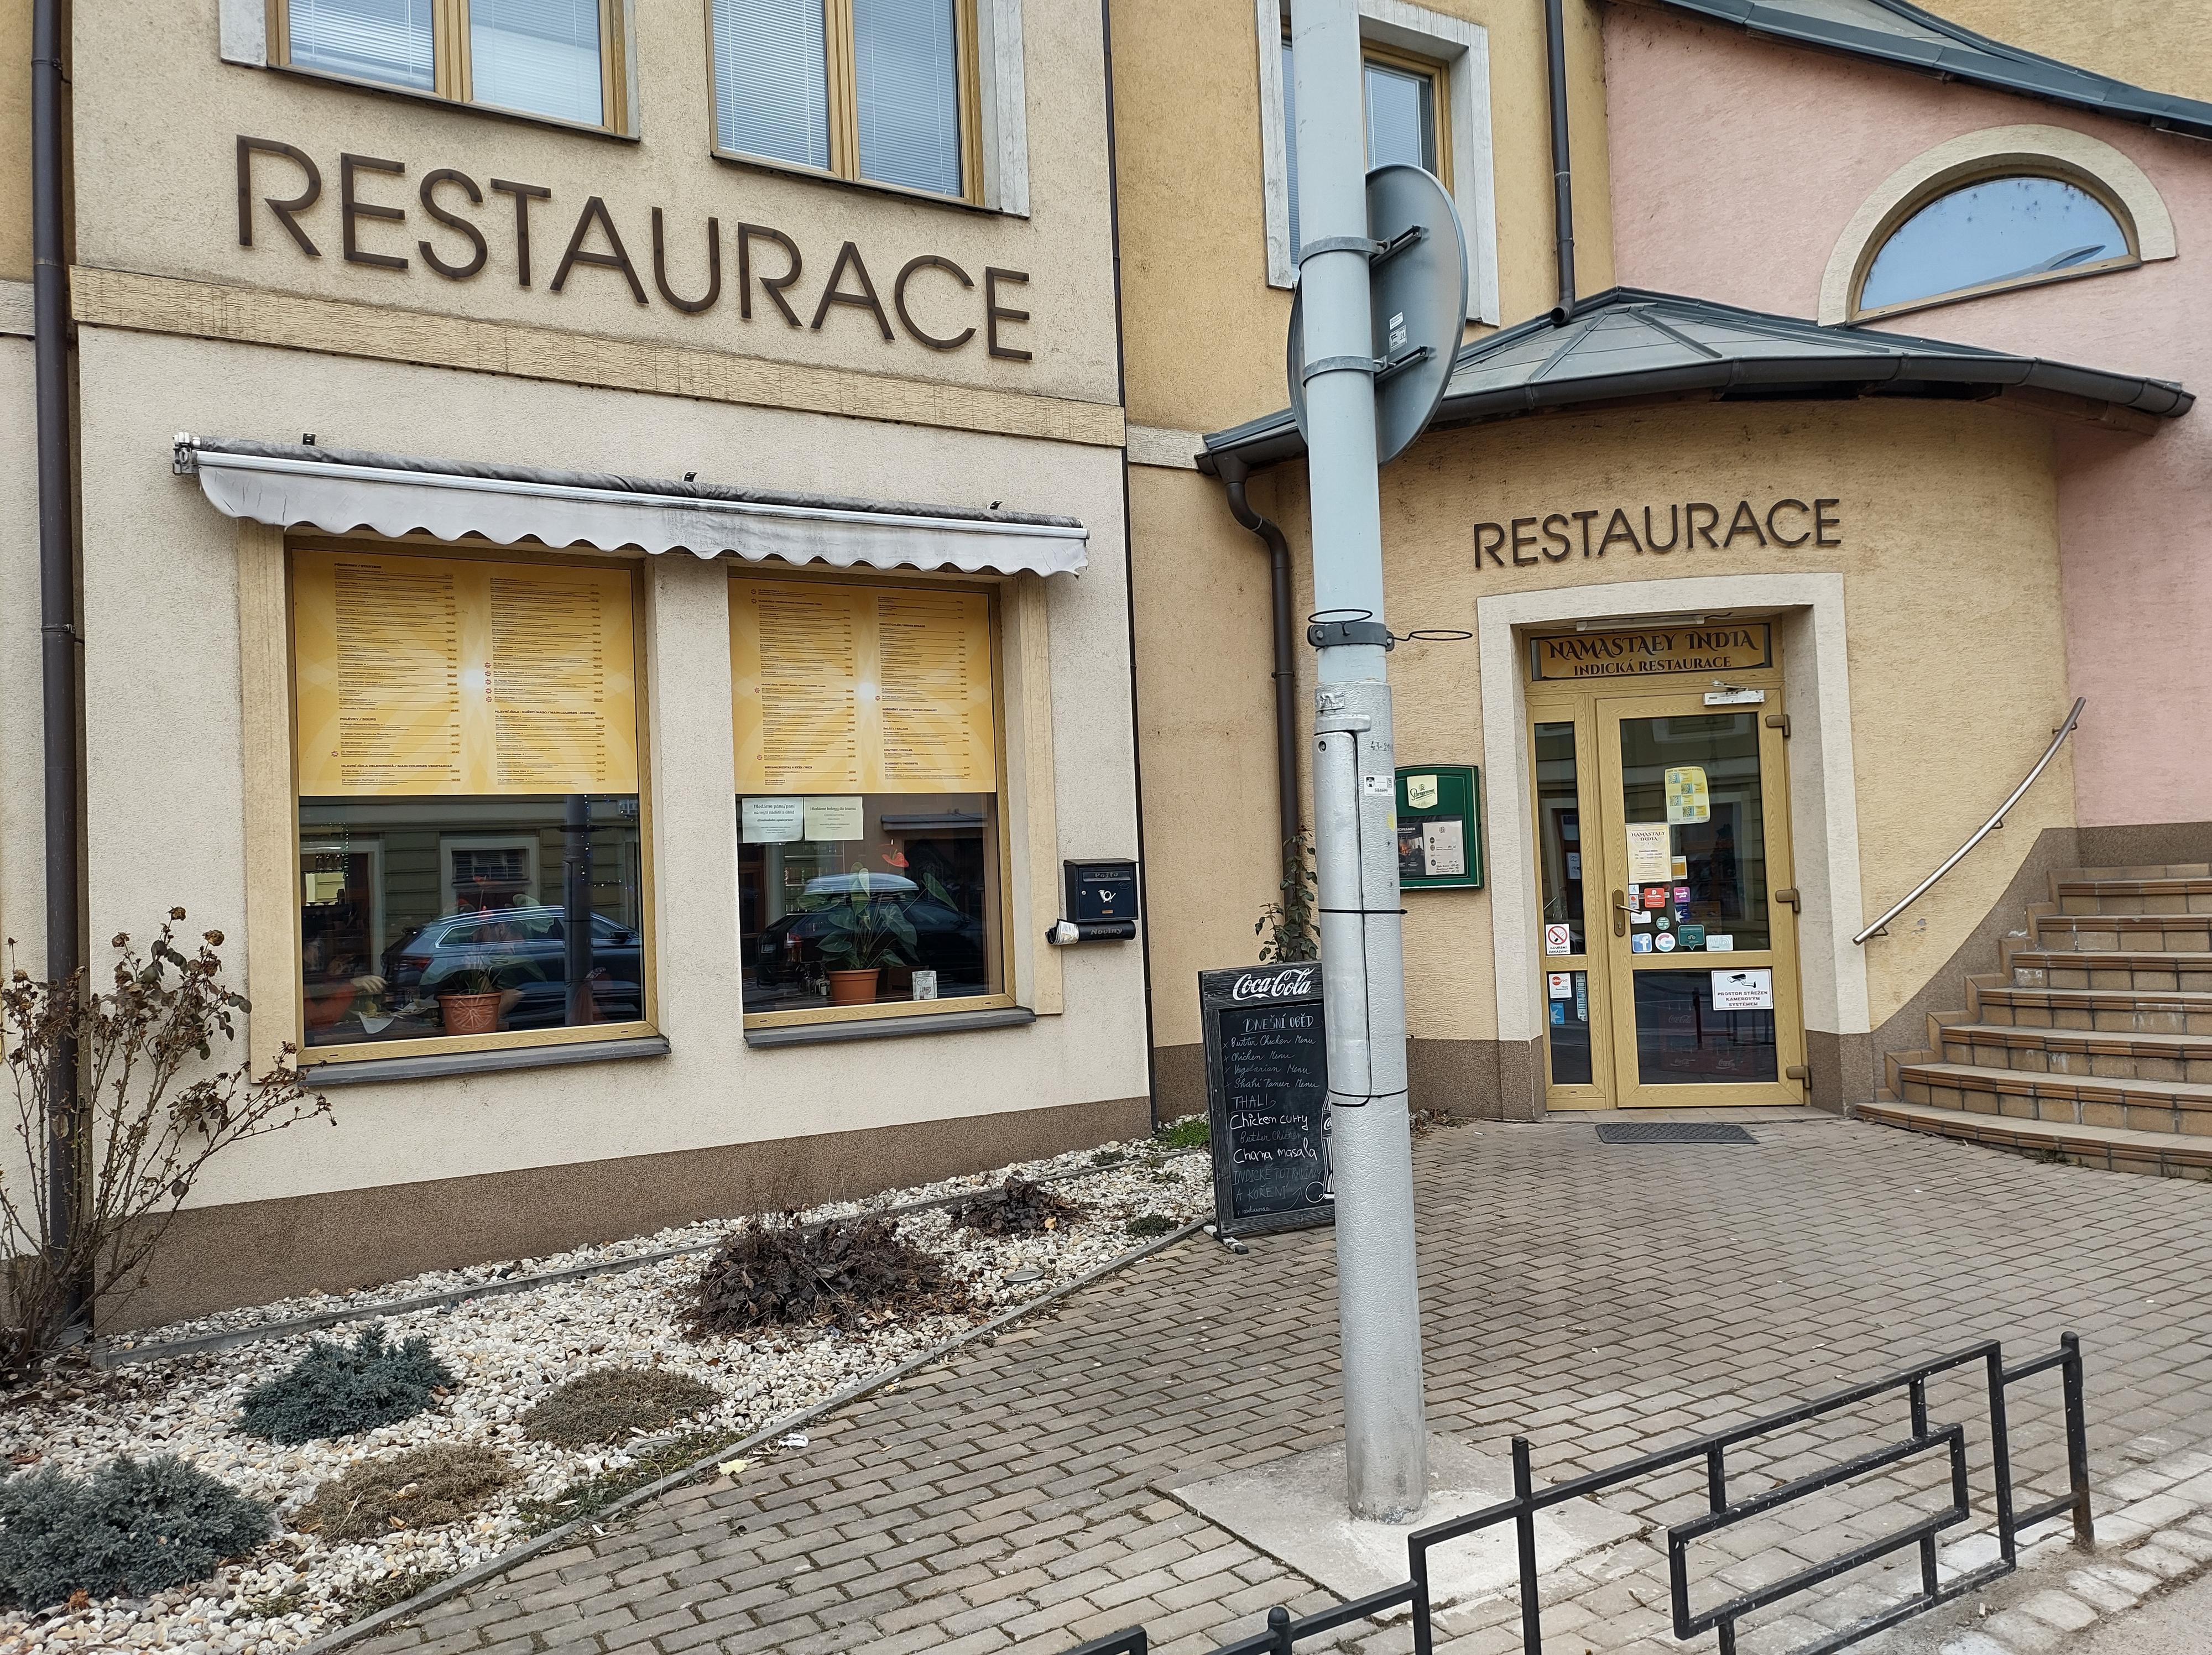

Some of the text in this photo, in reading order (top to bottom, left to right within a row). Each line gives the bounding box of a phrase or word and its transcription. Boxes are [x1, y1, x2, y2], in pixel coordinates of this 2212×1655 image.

[236, 134, 1032, 360] RESTAURACE
[1473, 498, 1841, 568] RESTAURACE
[1545, 630, 1759, 660] NAMASTAEY INDIA
[1574, 656, 1731, 676] INDICKÁ RESTAURACE
[1410, 787, 1436, 801] Staropramen
[1233, 968, 1315, 1001] Coca-Cola
[1243, 1012, 1314, 1032] DNEŠNÍ OBĚD
[1260, 1035, 1292, 1046] Chicken
[1295, 1035, 1316, 1045] Menu
[1231, 1050, 1296, 1062] Chicken Menu
[1234, 1063, 1313, 1078] Vegetarian Menu
[1295, 1079, 1321, 1088] Menu
[1231, 1094, 1269, 1110] THALI
[1230, 1112, 1277, 1130] Chicken
[1280, 1115, 1308, 1131] curry
[1233, 1162, 1322, 1186] INDICKÉ POTRAVINY
[1248, 1181, 1290, 1202] KOŘENÍ
